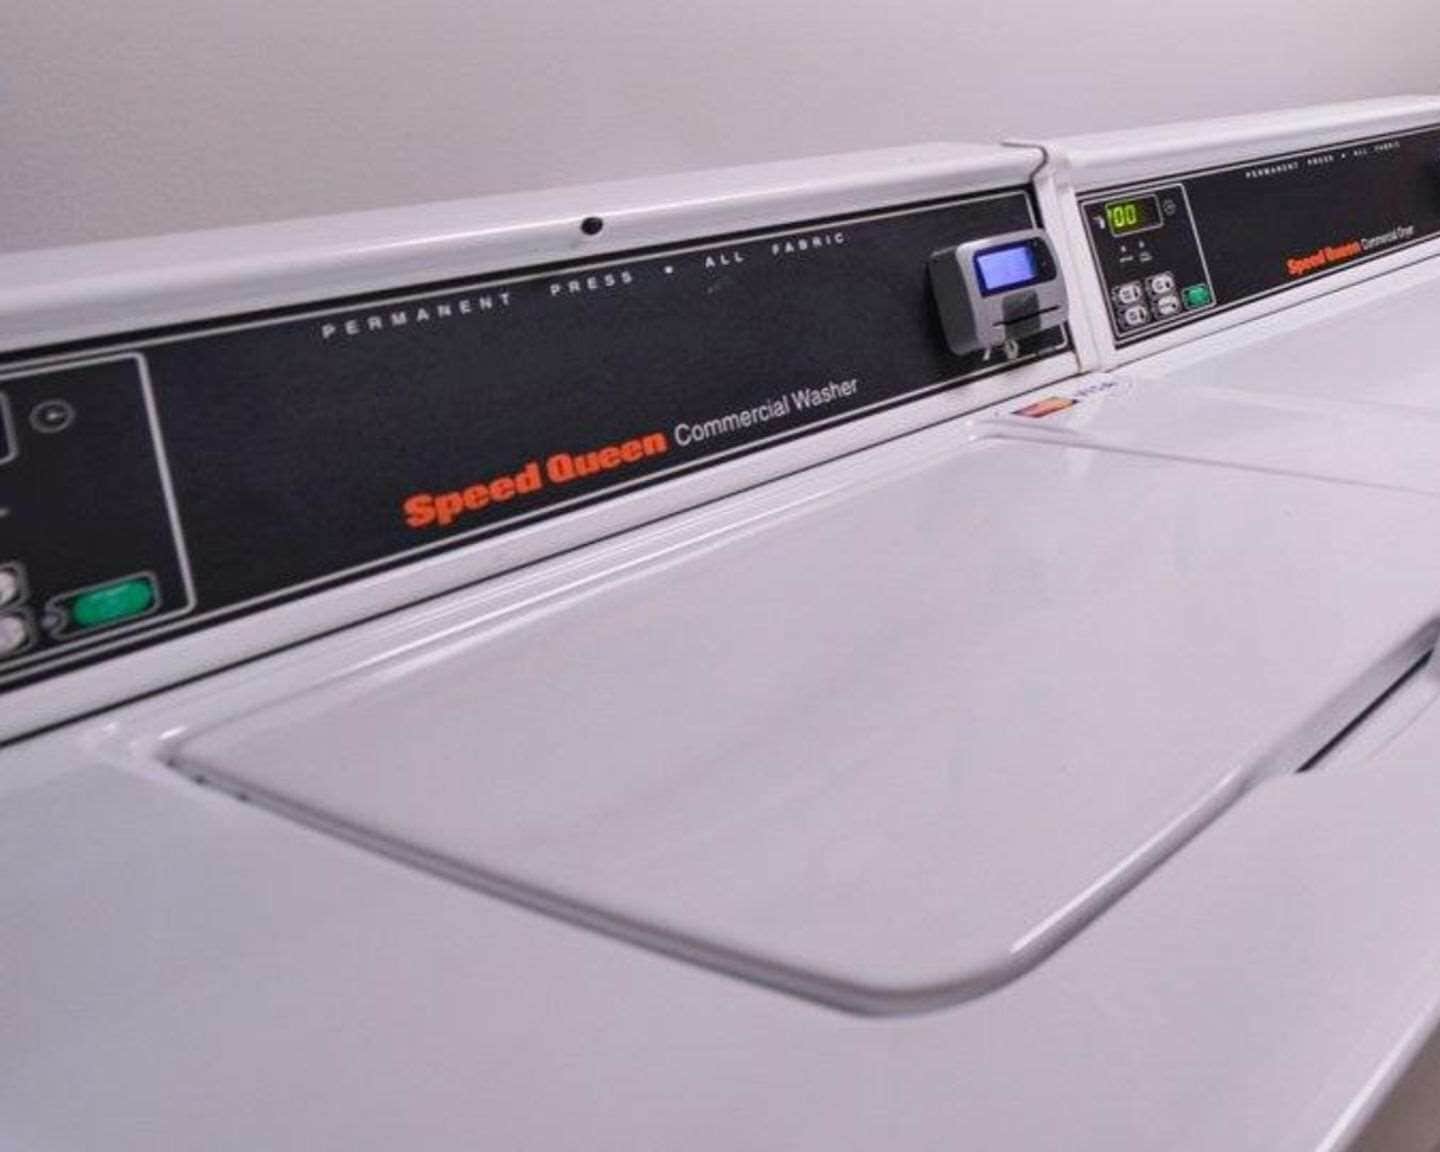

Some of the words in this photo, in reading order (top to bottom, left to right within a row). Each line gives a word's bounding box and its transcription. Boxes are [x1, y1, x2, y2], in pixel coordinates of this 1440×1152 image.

[322, 292, 513, 339] PERMANENT
[550, 270, 634, 296] PRESS
[705, 252, 744, 269] ALL
[772, 232, 845, 256] FABRIC
[1286, 248, 1326, 275] Speed
[403, 462, 543, 529] Speed
[546, 431, 669, 484] Queen
[674, 397, 790, 447] Commercial
[793, 377, 859, 411] Washer
